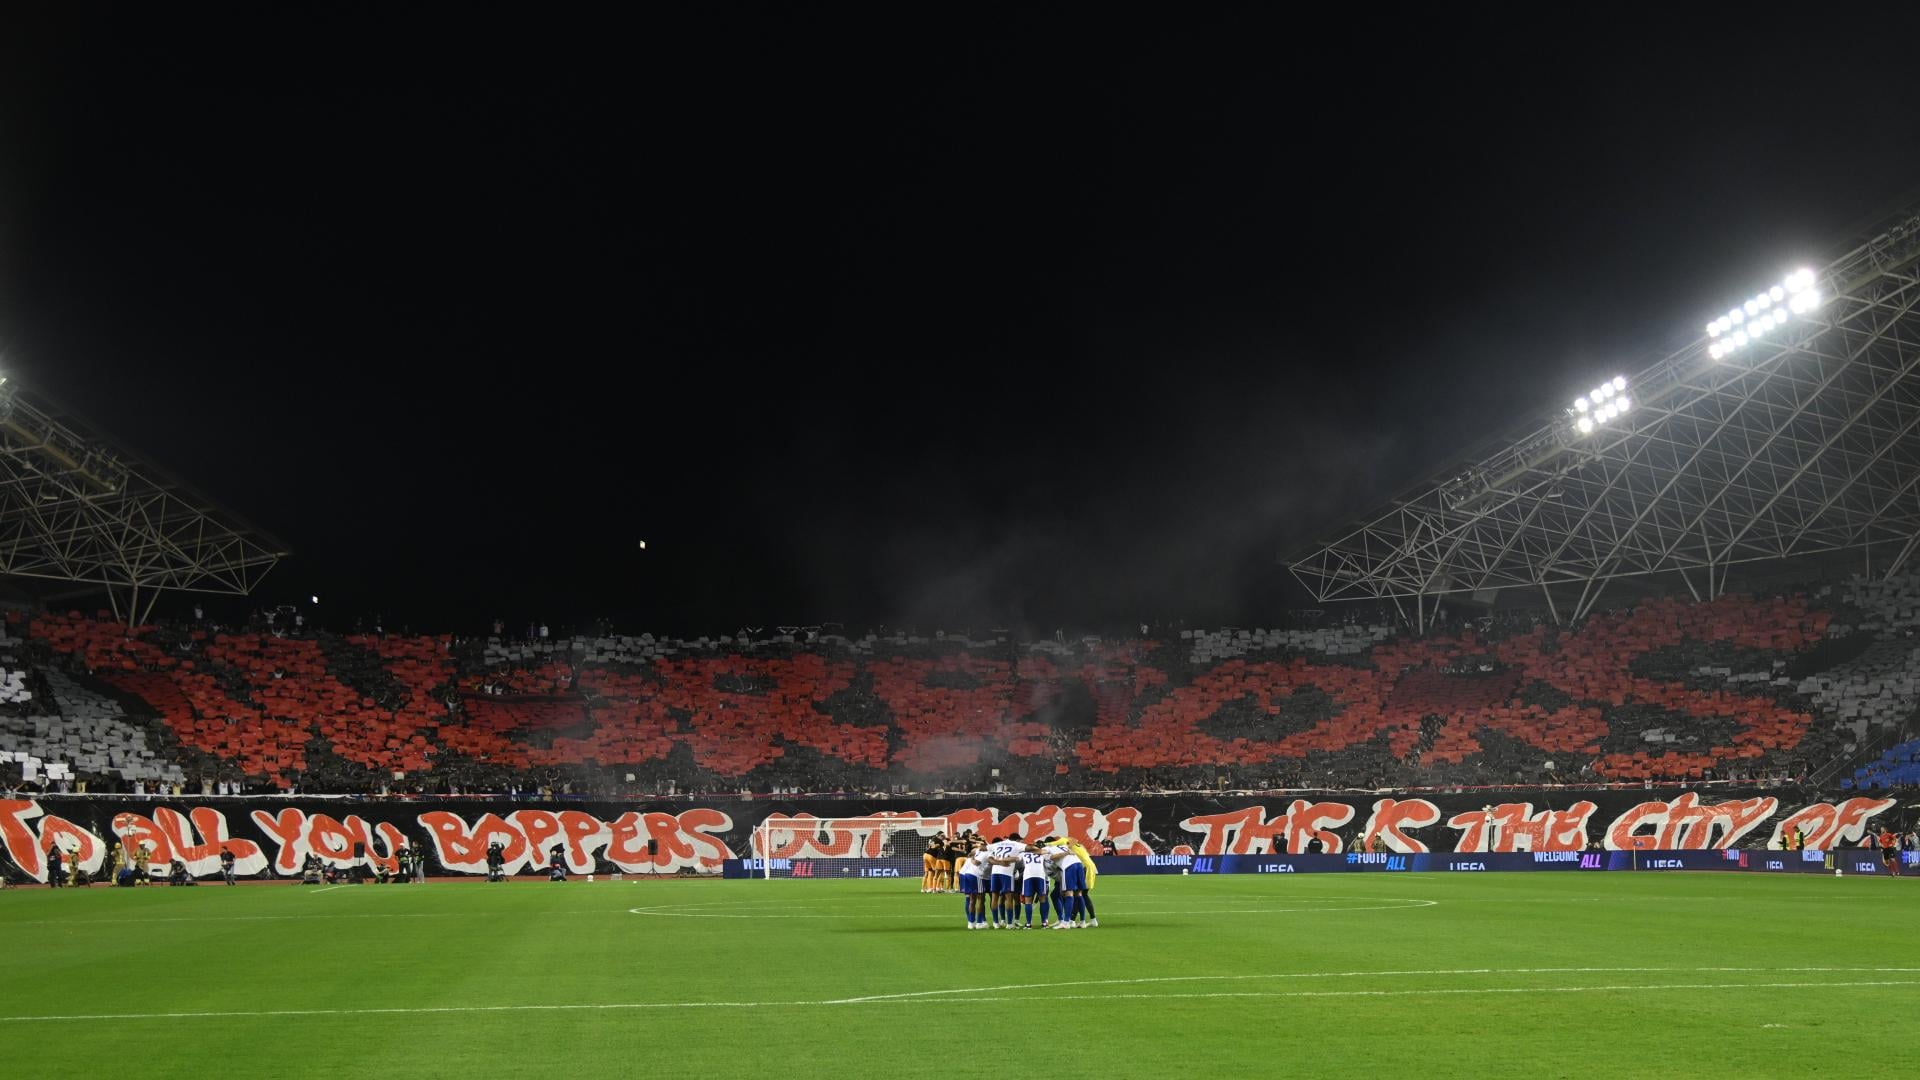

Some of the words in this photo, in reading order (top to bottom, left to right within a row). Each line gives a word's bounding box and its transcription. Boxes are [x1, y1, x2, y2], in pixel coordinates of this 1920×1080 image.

[0, 799, 107, 884] TO
[251, 807, 410, 876] YOU
[417, 808, 738, 876] BOPPERS
[750, 811, 922, 859] OUT
[1179, 799, 1355, 855] THIS
[1355, 798, 1441, 854] IS
[1447, 800, 1598, 853] THE
[1603, 791, 1778, 851] CITY
[996, 846, 1013, 859] 22
[1023, 853, 1042, 864] 32
[1534, 850, 1580, 862] WELCOME
[1580, 854, 1601, 869] ALL
[791, 861, 815, 877] ALL
[1145, 854, 1192, 866] WELCOME
[1192, 857, 1214, 873] ALL
[1385, 855, 1407, 871] ALL
